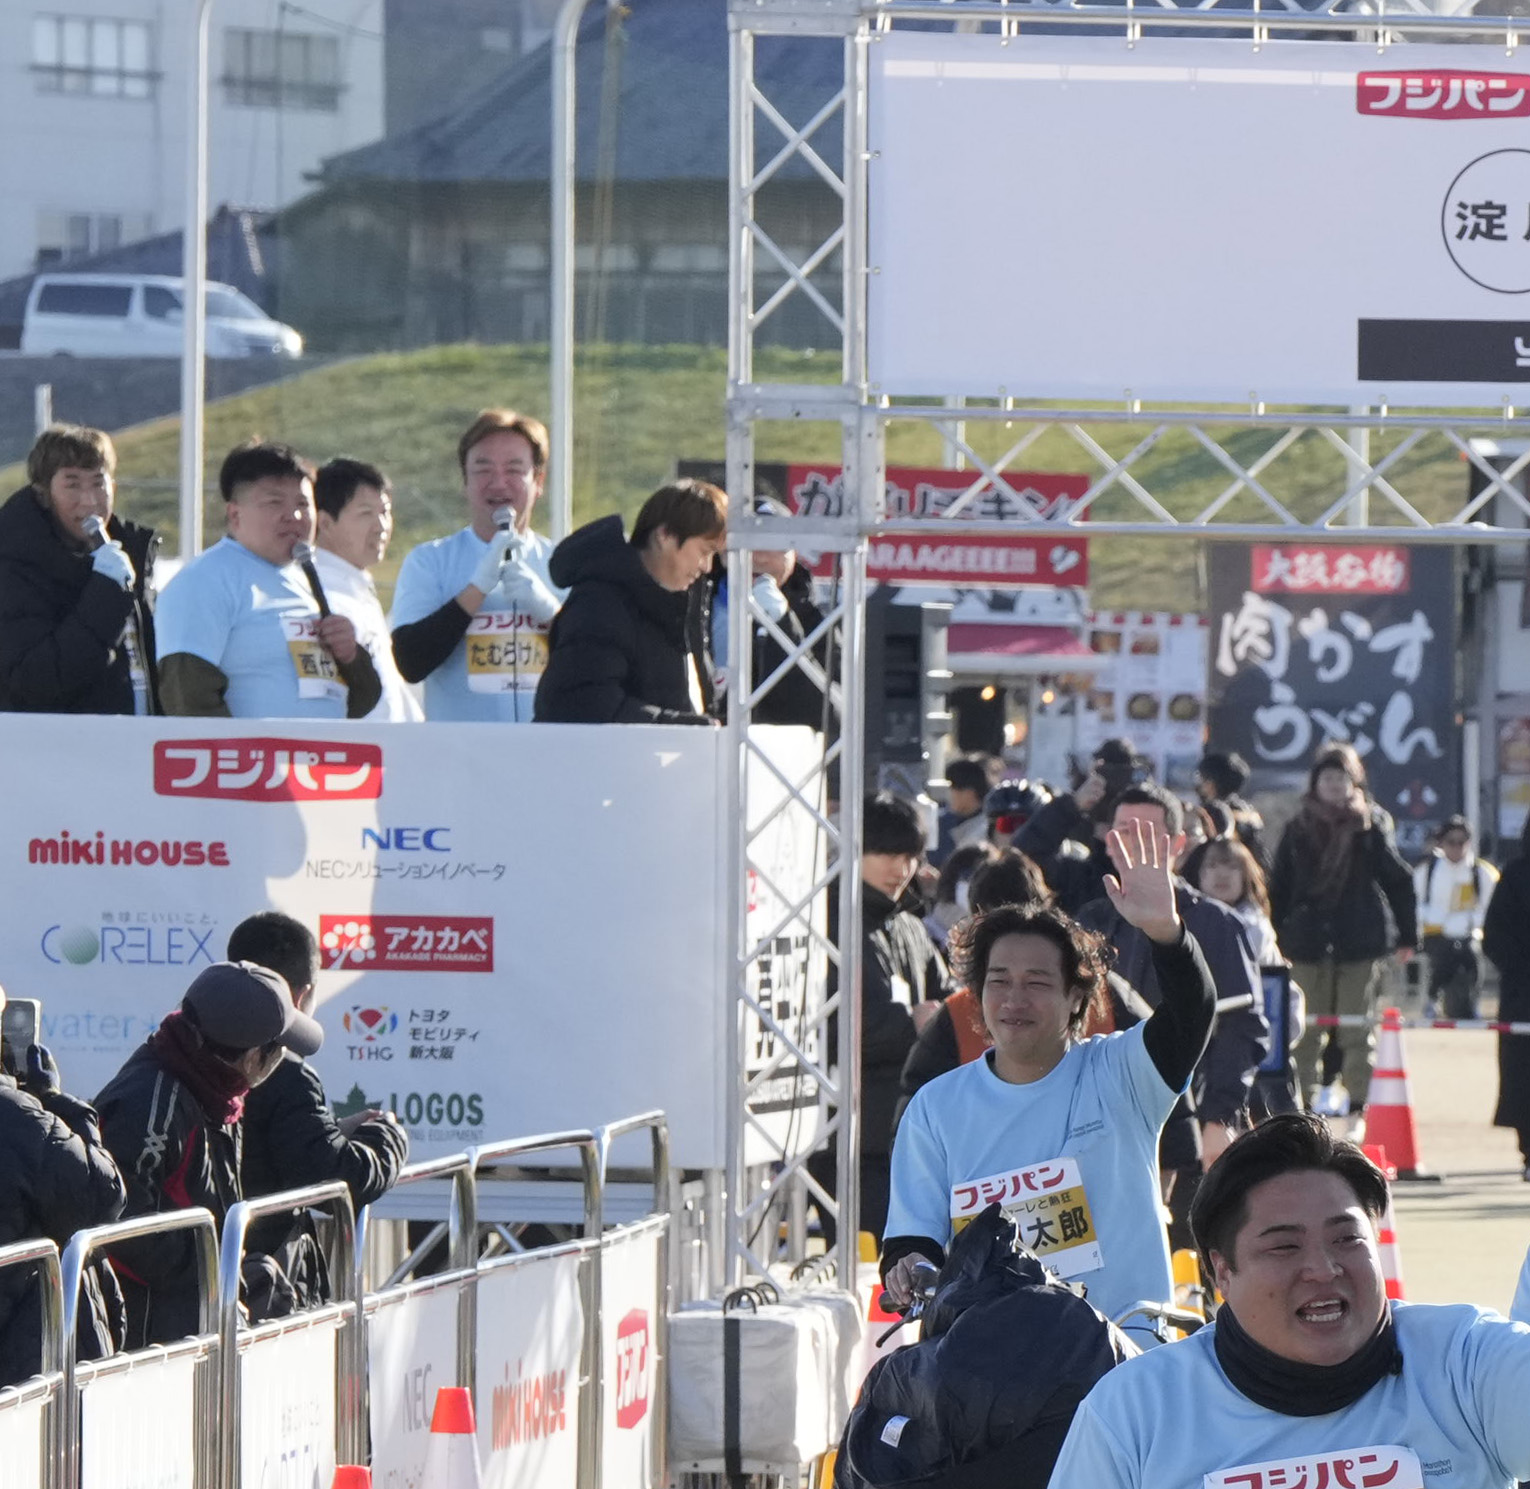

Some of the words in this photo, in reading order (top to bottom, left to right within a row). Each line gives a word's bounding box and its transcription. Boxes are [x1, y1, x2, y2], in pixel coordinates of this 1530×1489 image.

[1364, 76, 1528, 113] フジパン
[1260, 549, 1409, 589] 大阪名物
[163, 746, 372, 793] フジパン
[110, 837, 231, 868] HOUSE
[361, 827, 452, 852] NEC
[305, 859, 507, 881] NECソリューションイノベータ
[383, 925, 489, 951] アカカベ
[408, 1008, 451, 1023] トヨタ
[409, 1027, 480, 1042] モビリティ
[408, 1045, 456, 1061] 新大阪
[389, 1092, 485, 1127] LOGOS
[953, 1165, 1066, 1211] フジパン
[1017, 1205, 1090, 1251] 太郎
[523, 1368, 566, 1444] HOUSE
